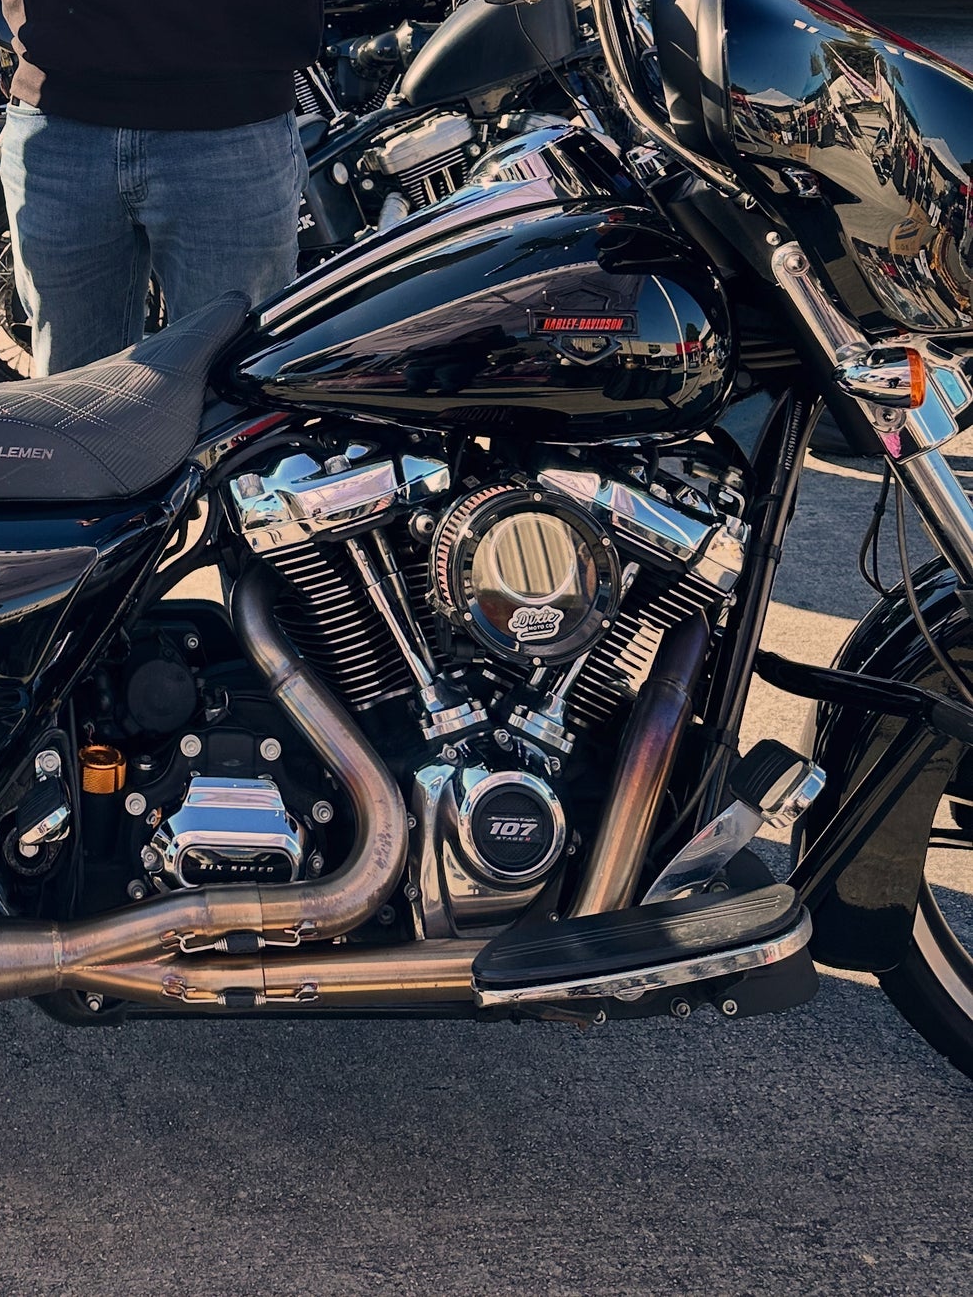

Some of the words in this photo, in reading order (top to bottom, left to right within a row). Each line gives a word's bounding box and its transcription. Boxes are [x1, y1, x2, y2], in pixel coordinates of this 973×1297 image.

[543, 317, 624, 331] HARLEY-DAVIDSON
[512, 609, 560, 629] Dixie
[490, 822, 538, 836] 107
